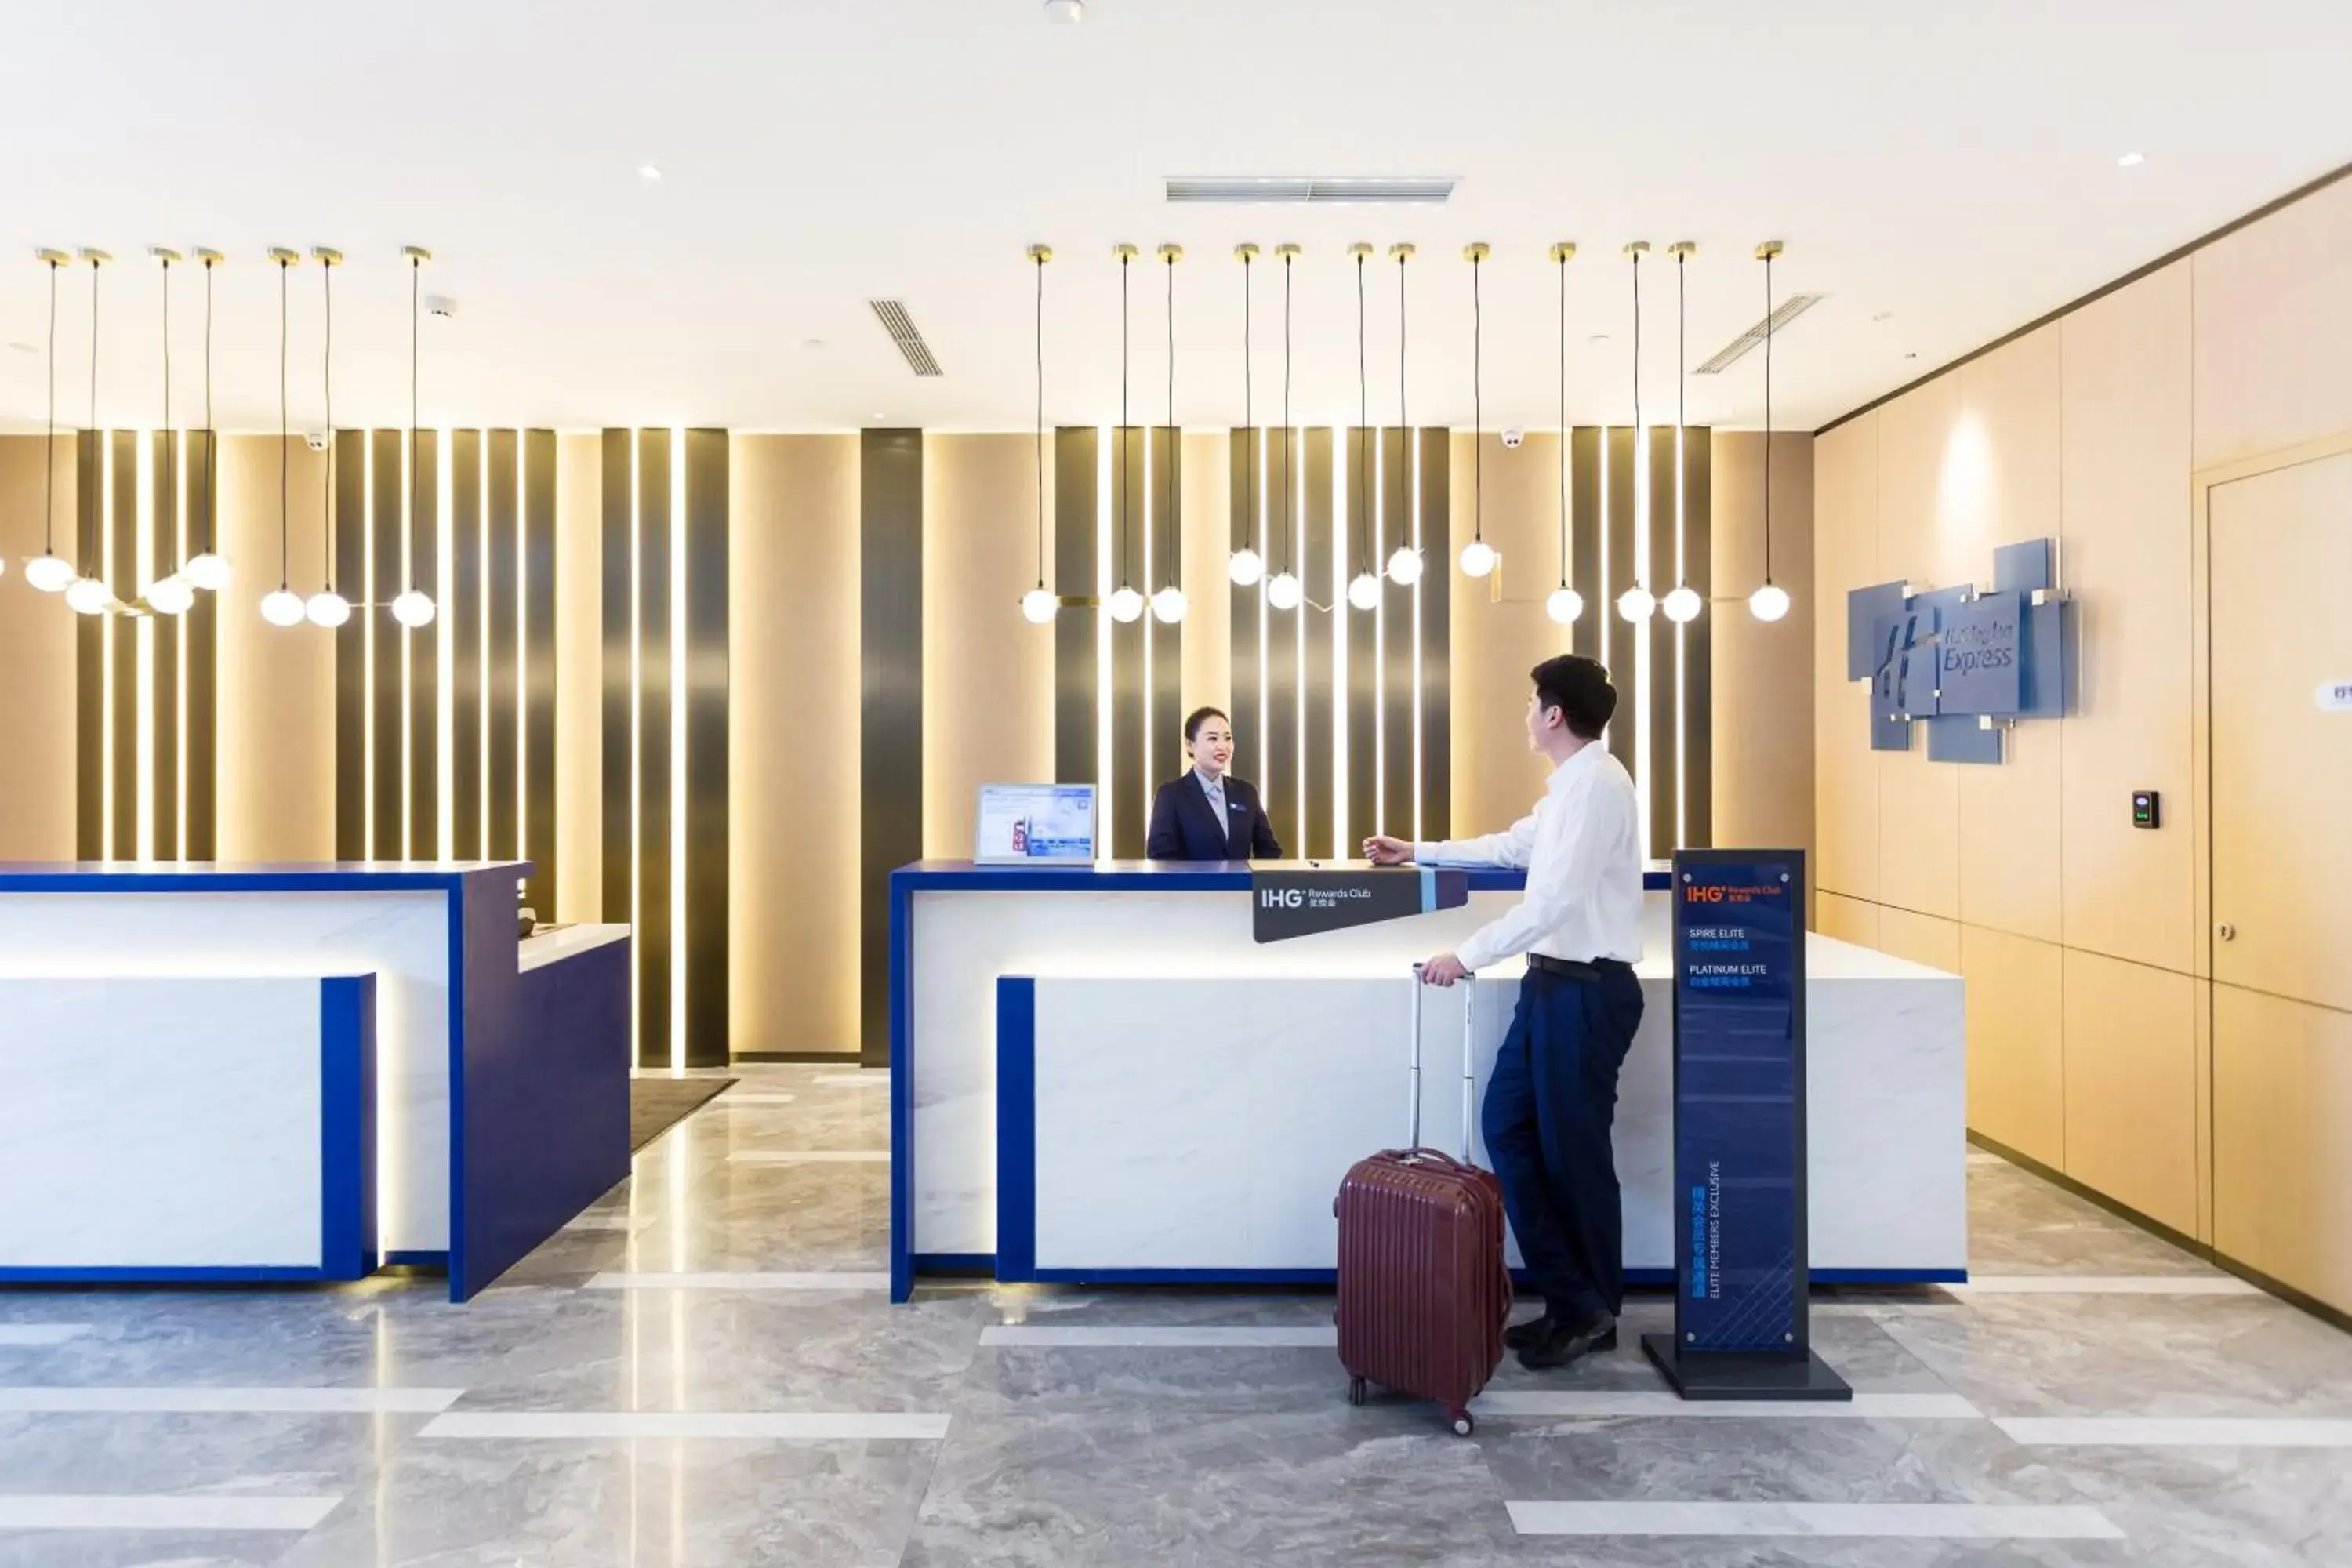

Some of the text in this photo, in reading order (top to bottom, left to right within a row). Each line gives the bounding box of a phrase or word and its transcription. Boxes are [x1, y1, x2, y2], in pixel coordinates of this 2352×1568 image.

[1944, 647, 2013, 676] Express
[1261, 888, 1302, 907] IHG
[1308, 888, 1348, 898] Rewards
[1349, 887, 1371, 898] Club
[1687, 886, 1722, 902] IHG
[1689, 928, 1744, 938] SPIRE ELITE
[1689, 965, 1767, 975] PLATINUM ELITE
[1710, 1160, 1719, 1298] ELITE MEMBERS EXCLUSIVE
